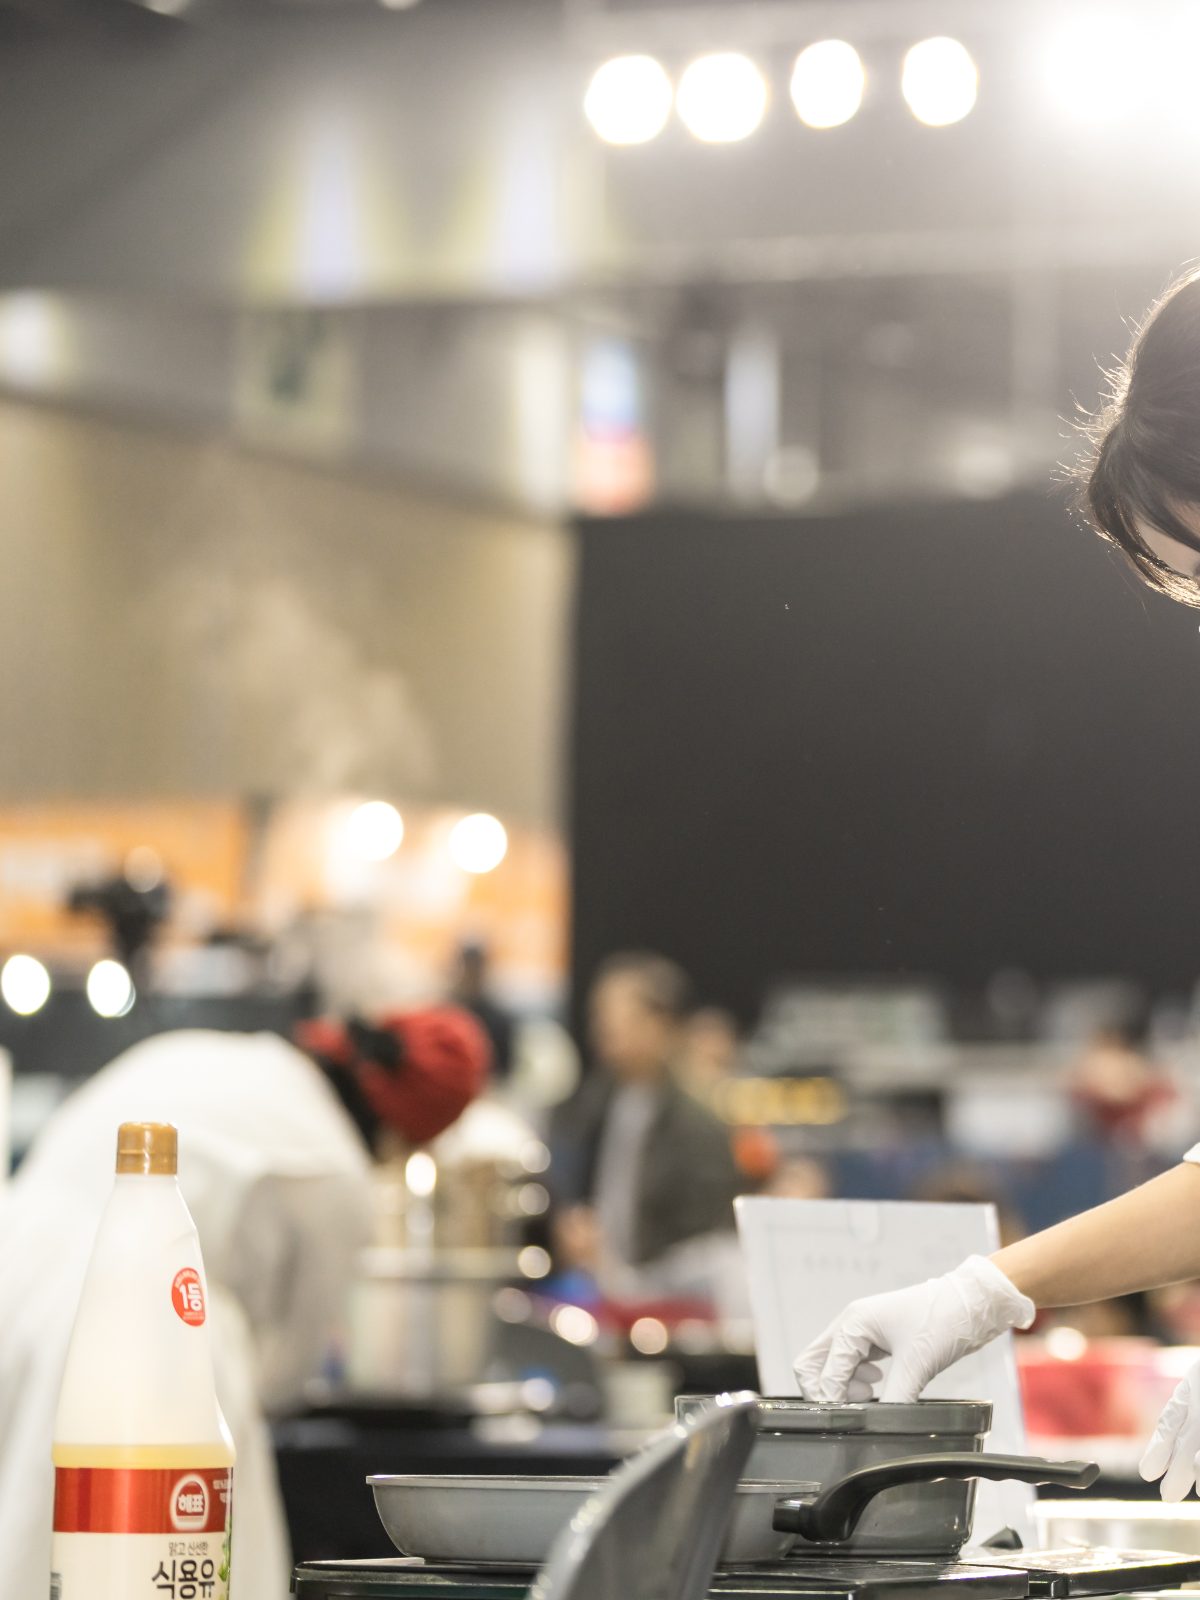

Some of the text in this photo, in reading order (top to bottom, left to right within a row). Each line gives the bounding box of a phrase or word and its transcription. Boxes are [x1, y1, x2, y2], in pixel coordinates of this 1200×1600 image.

[180, 1283, 202, 1311] 1등
[178, 1494, 204, 1513] 해표
[169, 1541, 208, 1557] 맑고 신선한
[152, 1559, 215, 1600] 식용유
